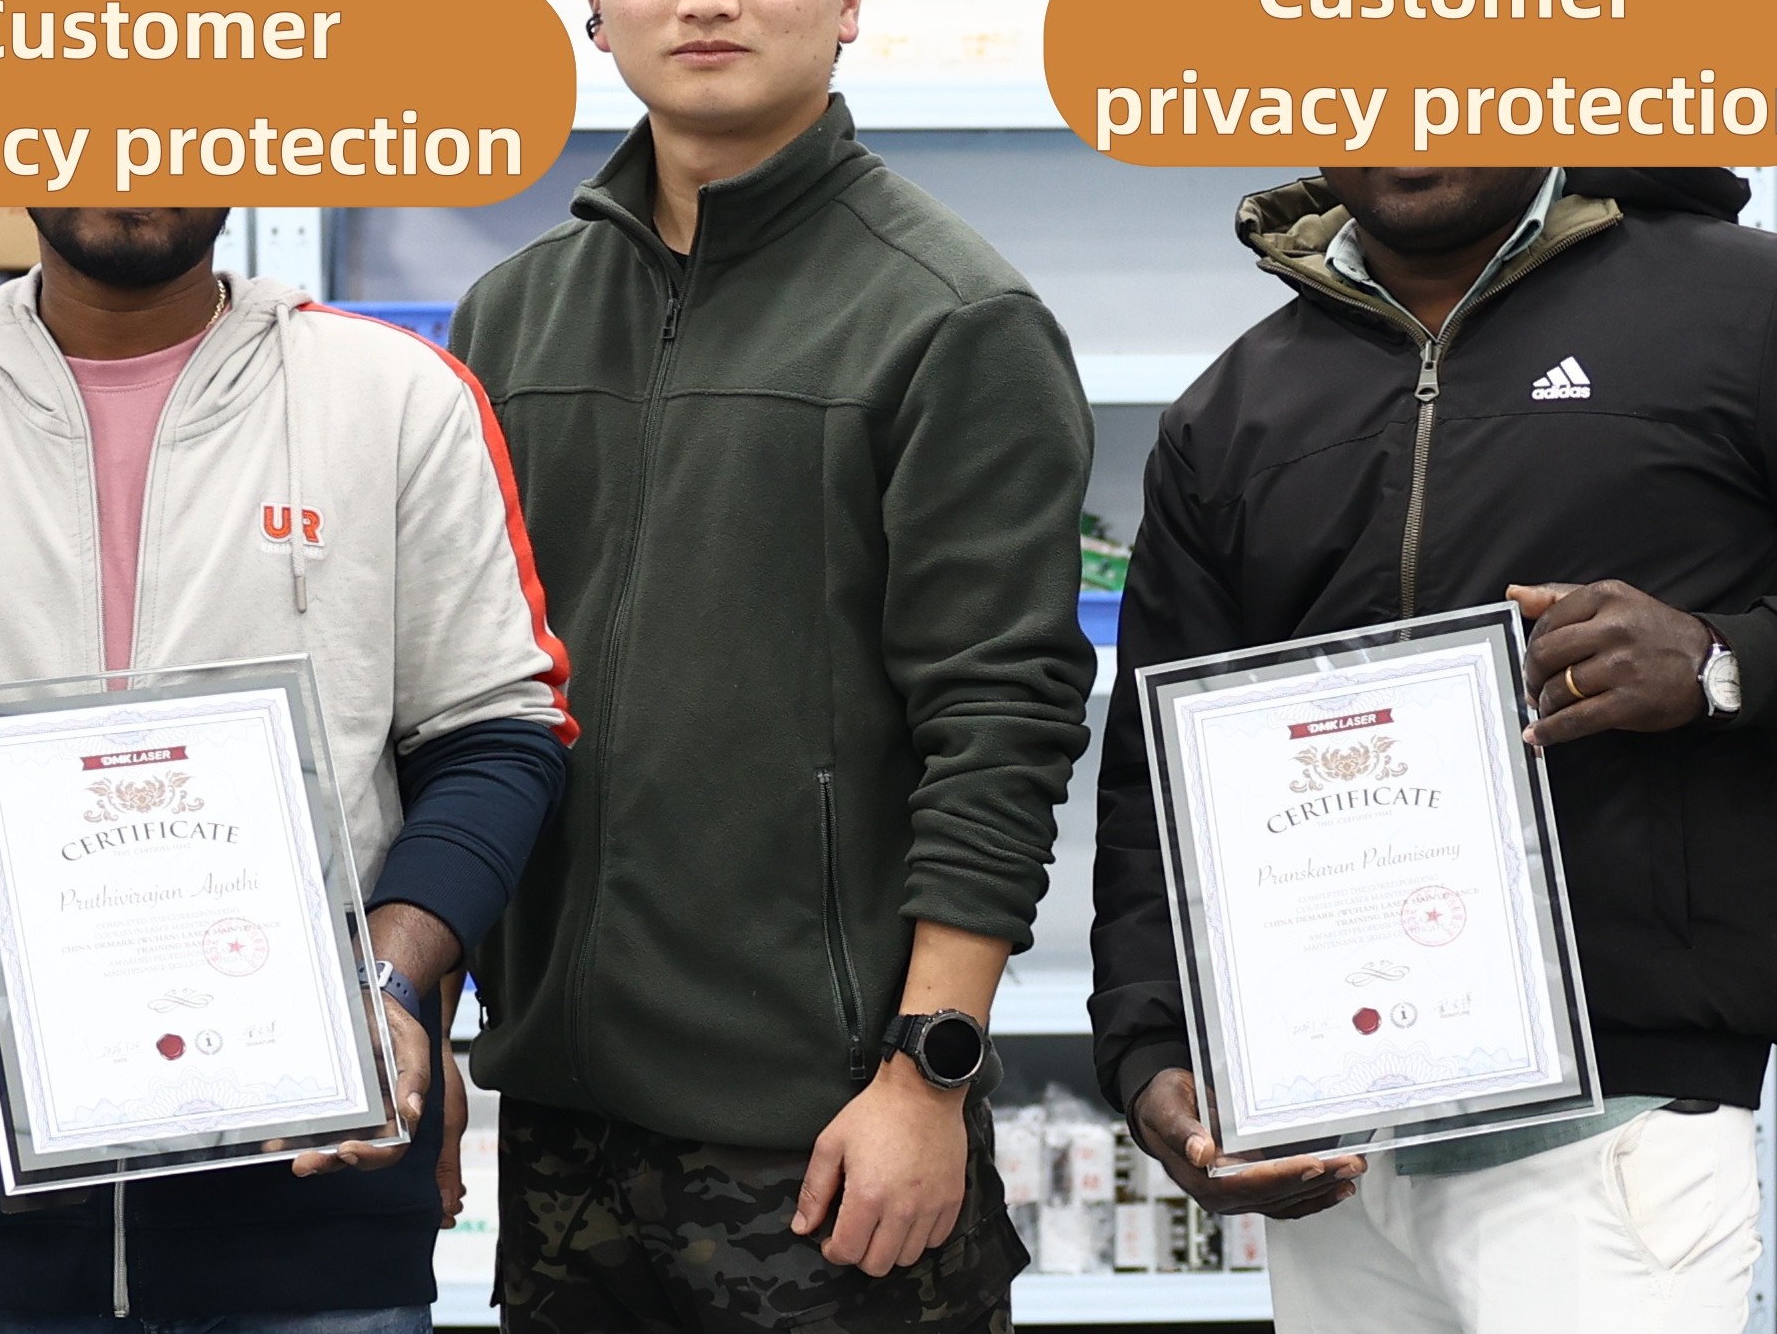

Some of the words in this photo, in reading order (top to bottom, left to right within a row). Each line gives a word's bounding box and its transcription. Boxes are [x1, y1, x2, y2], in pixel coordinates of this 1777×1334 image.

[1531, 383, 1591, 401] adidas
[261, 502, 324, 546] UR
[1308, 721, 1337, 734] DMK
[1339, 714, 1377, 729] LASER
[101, 754, 132, 766] DMK
[133, 750, 171, 763] LASER
[1266, 786, 1443, 834] CERTIFICATE
[61, 820, 241, 862] CERTIFICATE
[1257, 857, 1356, 887] Pranskaran
[1362, 843, 1461, 869] Palanisamy
[60, 884, 183, 912] Pruthivirajan
[190, 867, 259, 900] Ayothi
[1263, 918, 1293, 929] CHINA
[1296, 912, 1335, 923] DEMARK
[1335, 914, 1381, 927] TRAINING
[60, 944, 93, 954] CHINA
[94, 938, 135, 949] DEMARK
[135, 942, 182, 955] TRAINING
